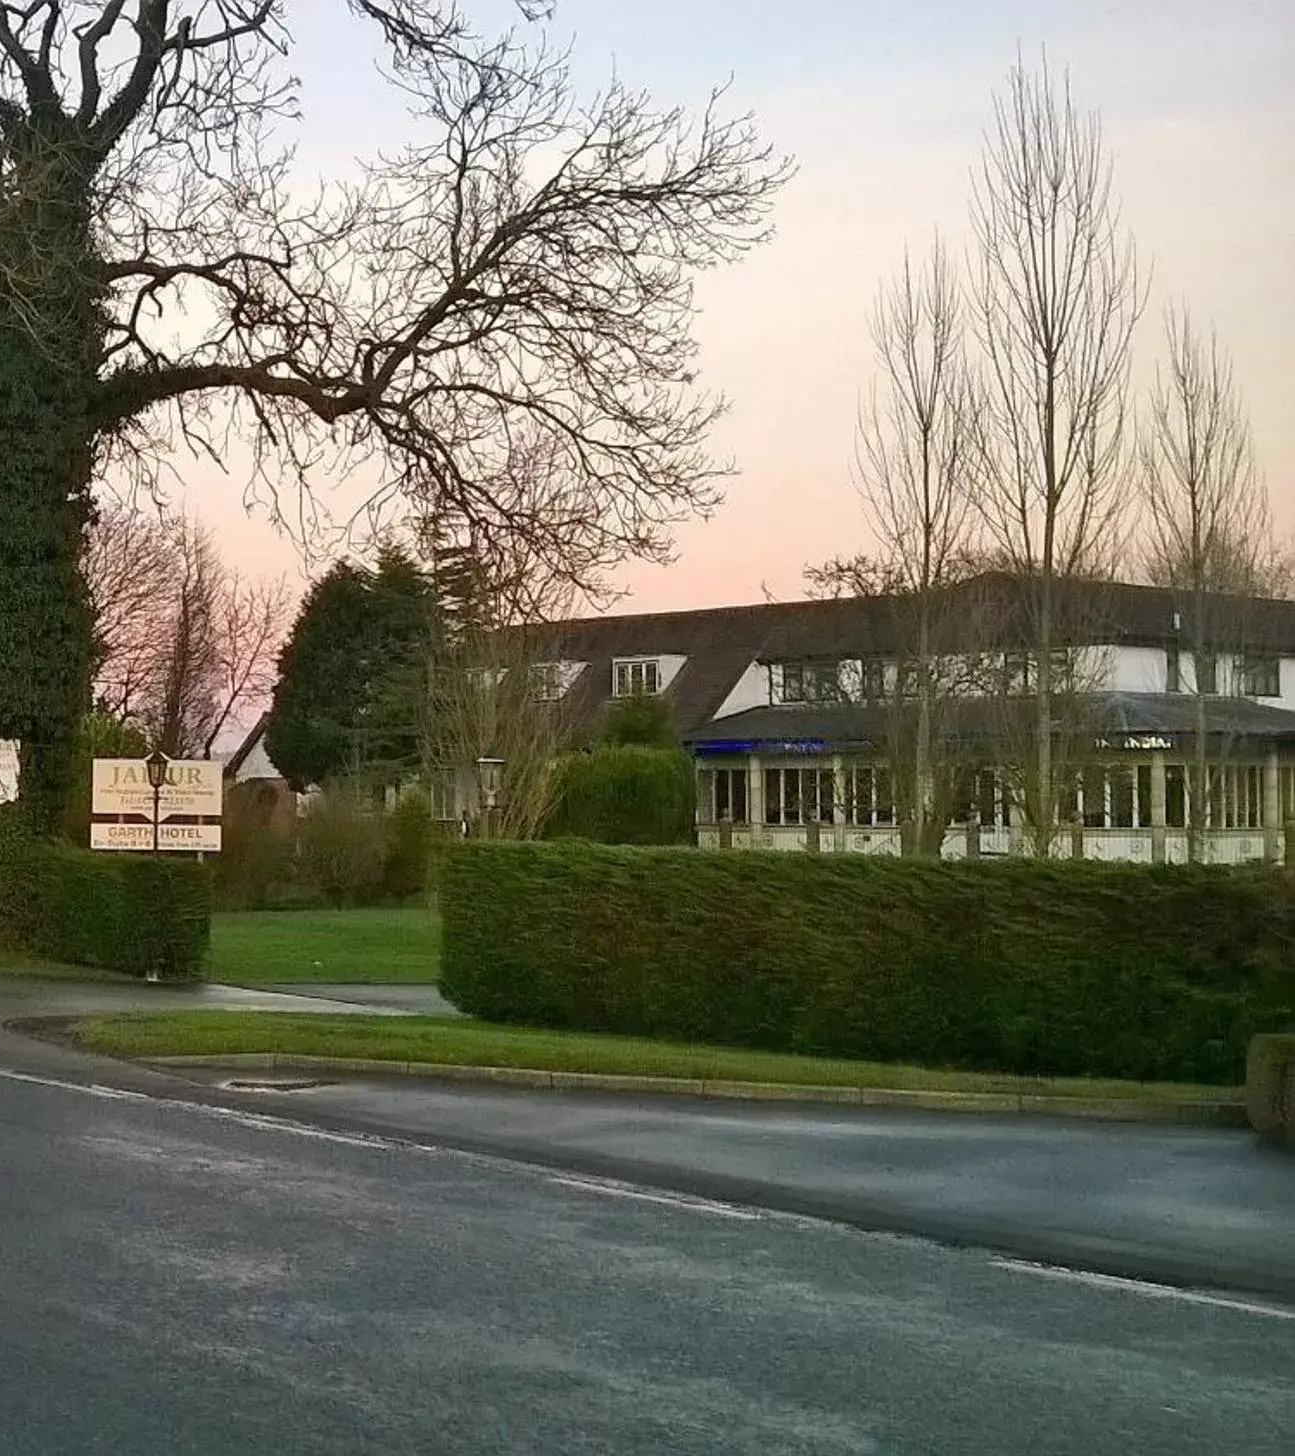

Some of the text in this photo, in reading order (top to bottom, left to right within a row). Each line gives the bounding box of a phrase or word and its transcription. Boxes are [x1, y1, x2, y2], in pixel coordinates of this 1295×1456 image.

[109, 766, 202, 787] JAIUR
[108, 826, 203, 839] GARTH HOTEL
